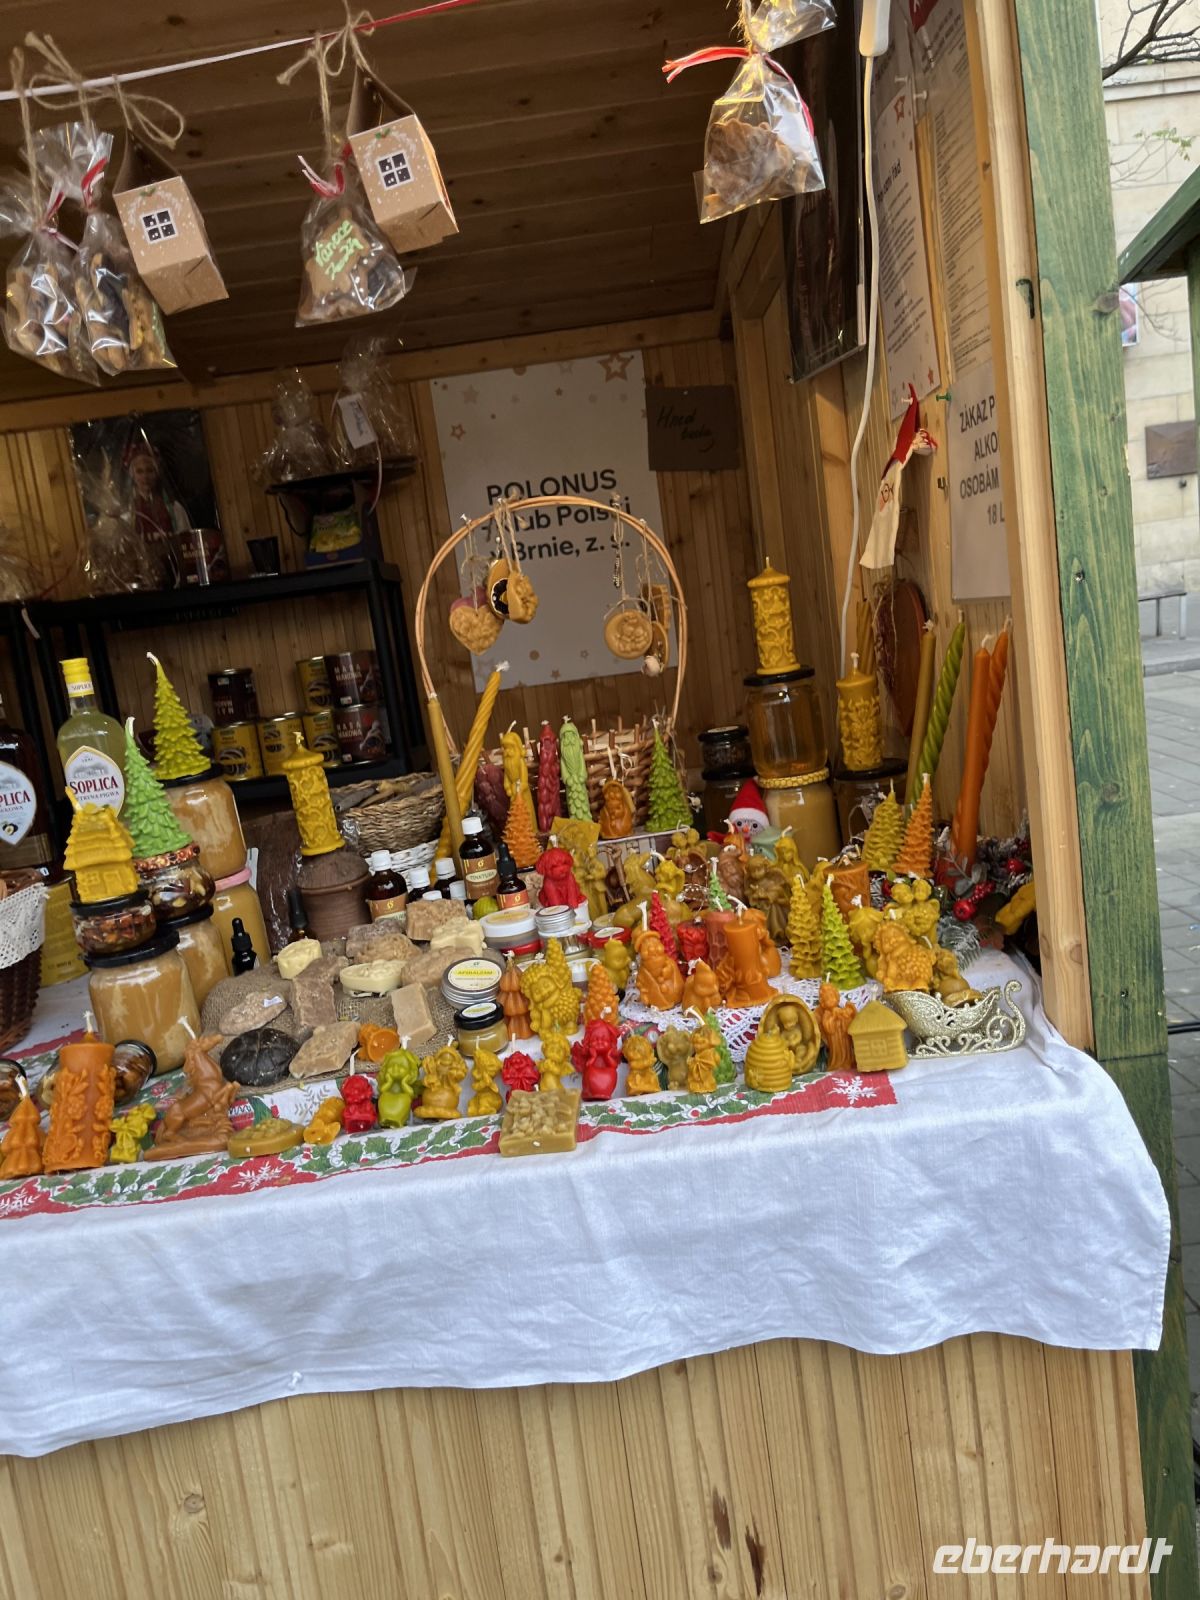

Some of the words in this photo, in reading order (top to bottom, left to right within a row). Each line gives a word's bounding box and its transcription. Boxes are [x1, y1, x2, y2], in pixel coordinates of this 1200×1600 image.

[959, 399, 988, 433] ZÁKAZ
[974, 431, 999, 461] ALKO
[486, 469, 617, 505] POLONUS
[959, 464, 1000, 499] OSOBÁM
[987, 503, 998, 525] 18
[511, 536, 581, 563] Brnie,
[585, 536, 605, 553] z.
[69, 776, 119, 795] SOPLICA
